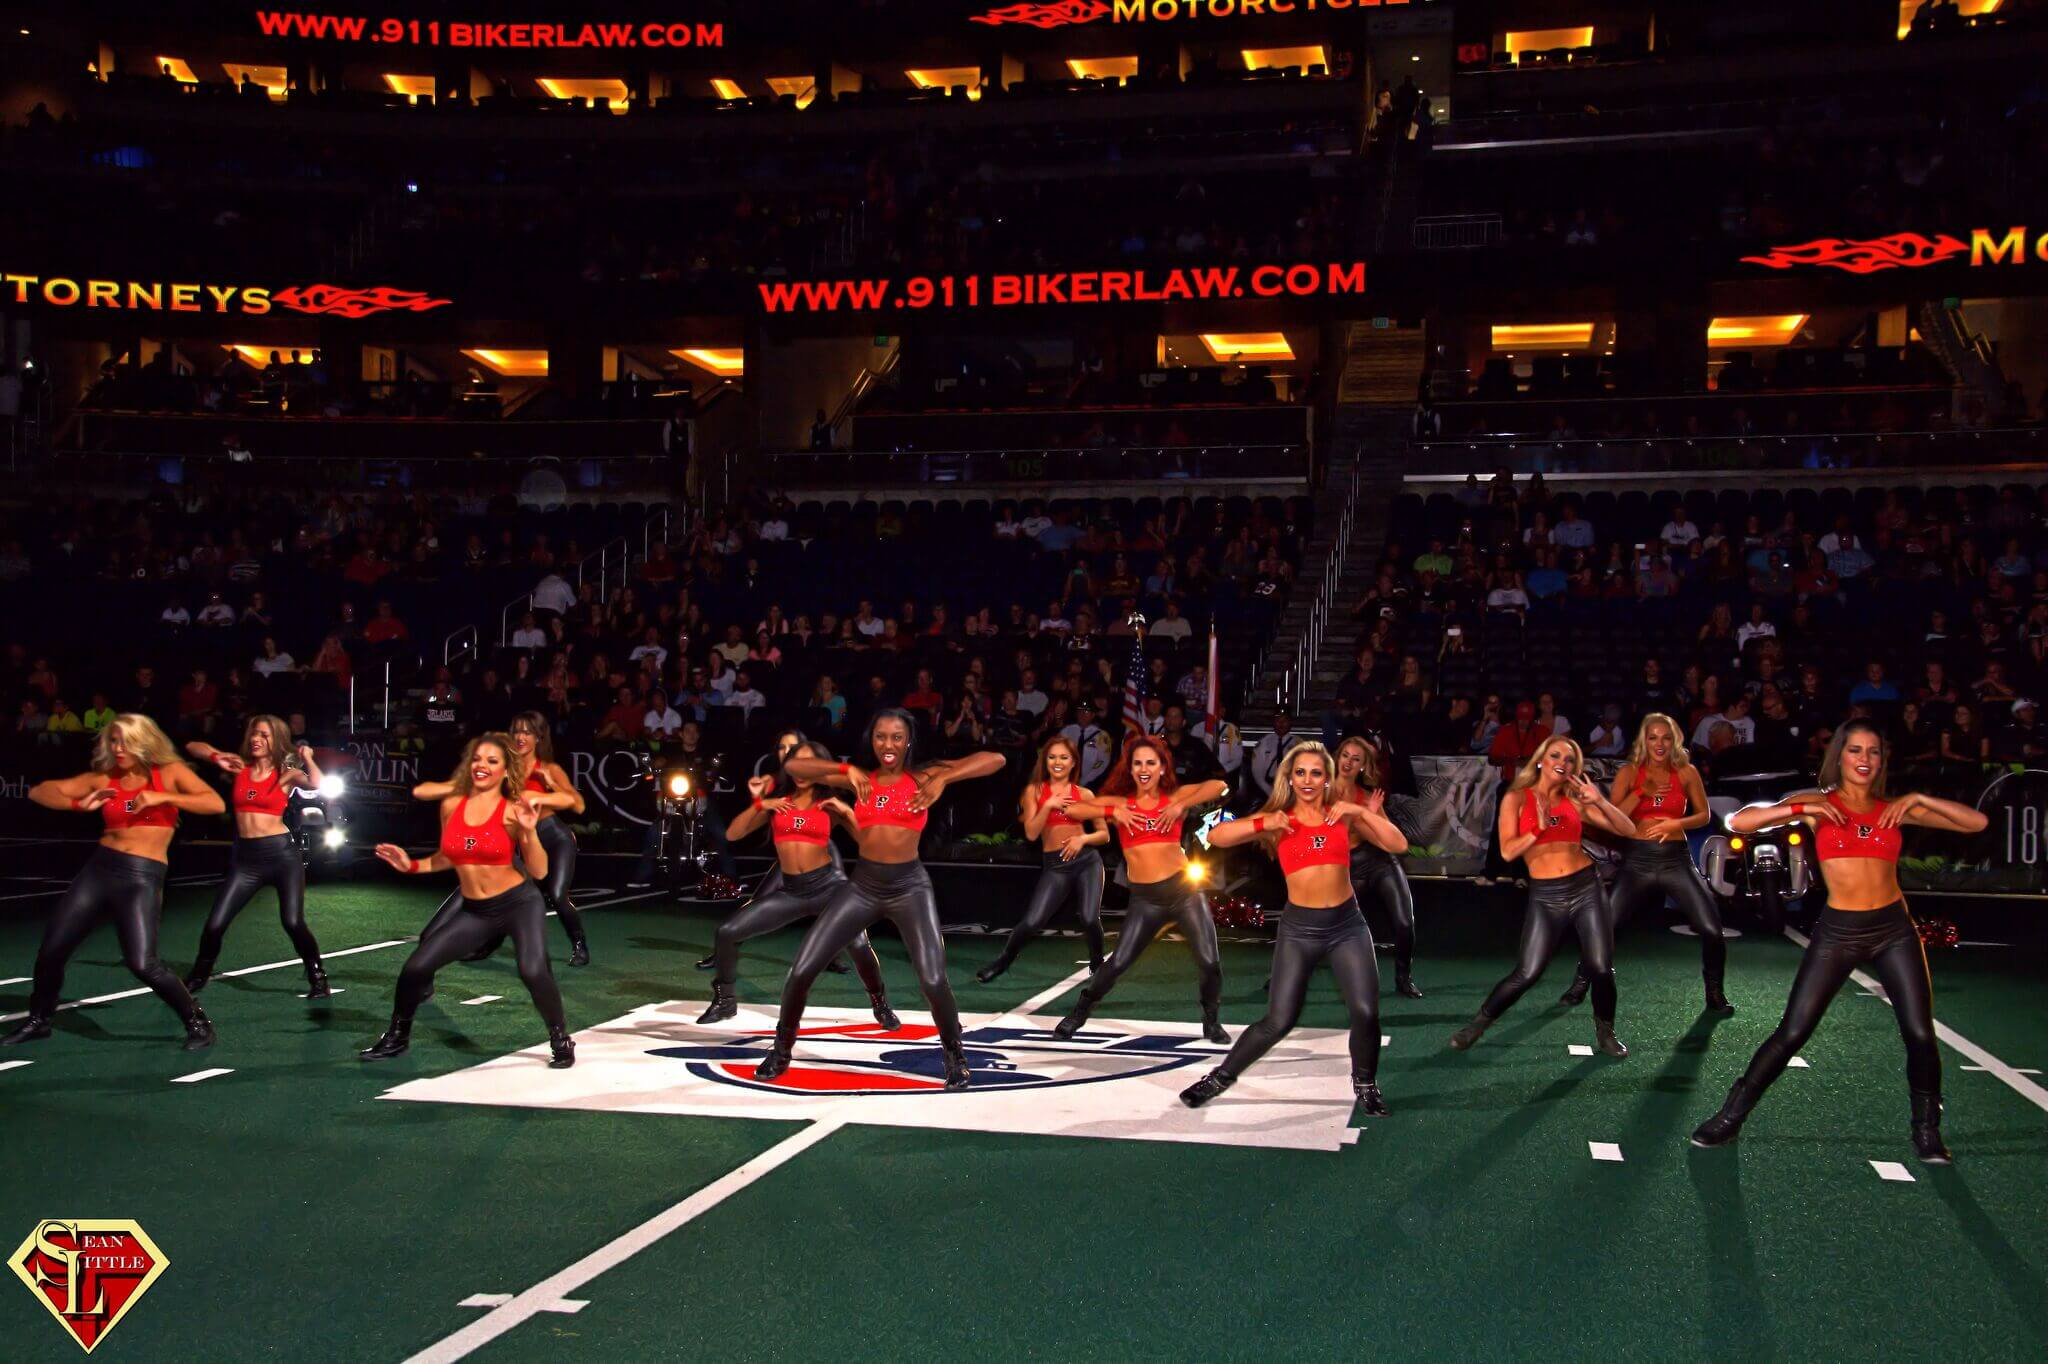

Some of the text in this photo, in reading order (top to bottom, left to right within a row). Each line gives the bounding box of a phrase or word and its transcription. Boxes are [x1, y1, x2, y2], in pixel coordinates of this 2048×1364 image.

[257, 12, 723, 48] WWW.911BIKERLAW.COM
[0, 274, 271, 314] TORNEYS
[759, 262, 1366, 313] WWW.911BIKERLAW.COM
